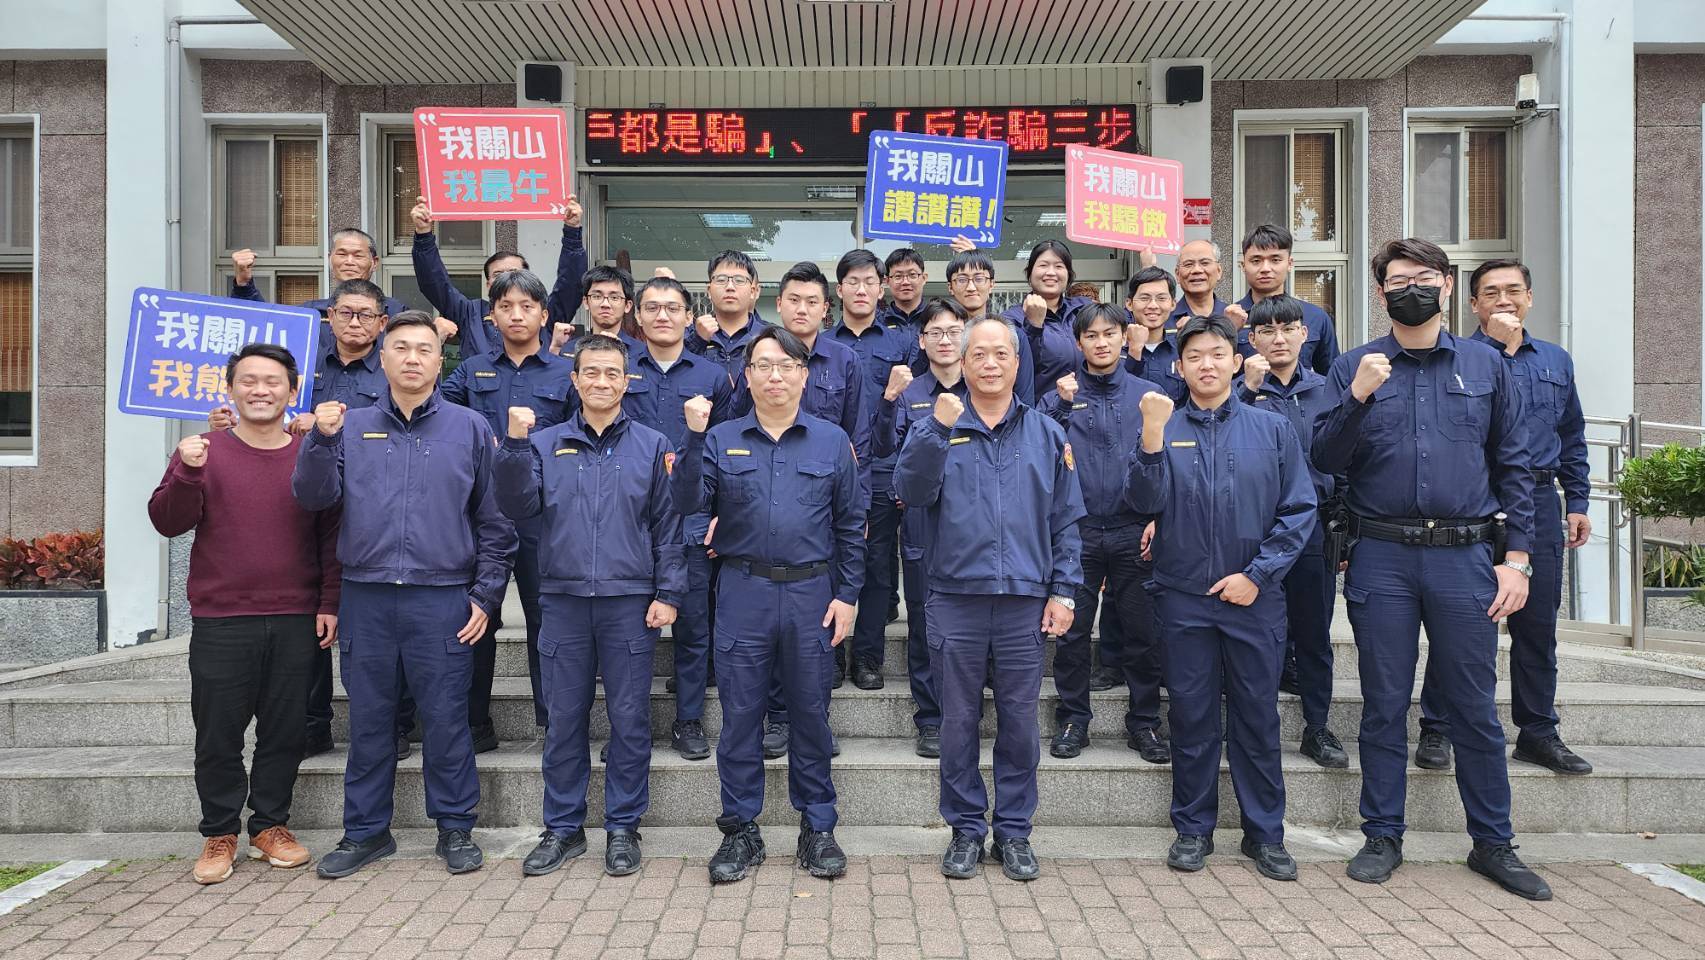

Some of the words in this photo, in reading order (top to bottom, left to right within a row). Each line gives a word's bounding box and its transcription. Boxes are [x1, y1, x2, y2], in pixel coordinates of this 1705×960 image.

[438, 126, 547, 161] 我關山
[442, 169, 549, 203] 我最牛
[887, 149, 984, 187] 我關山
[1083, 163, 1167, 201] 我關山
[1083, 200, 1168, 239] 我驕傲
